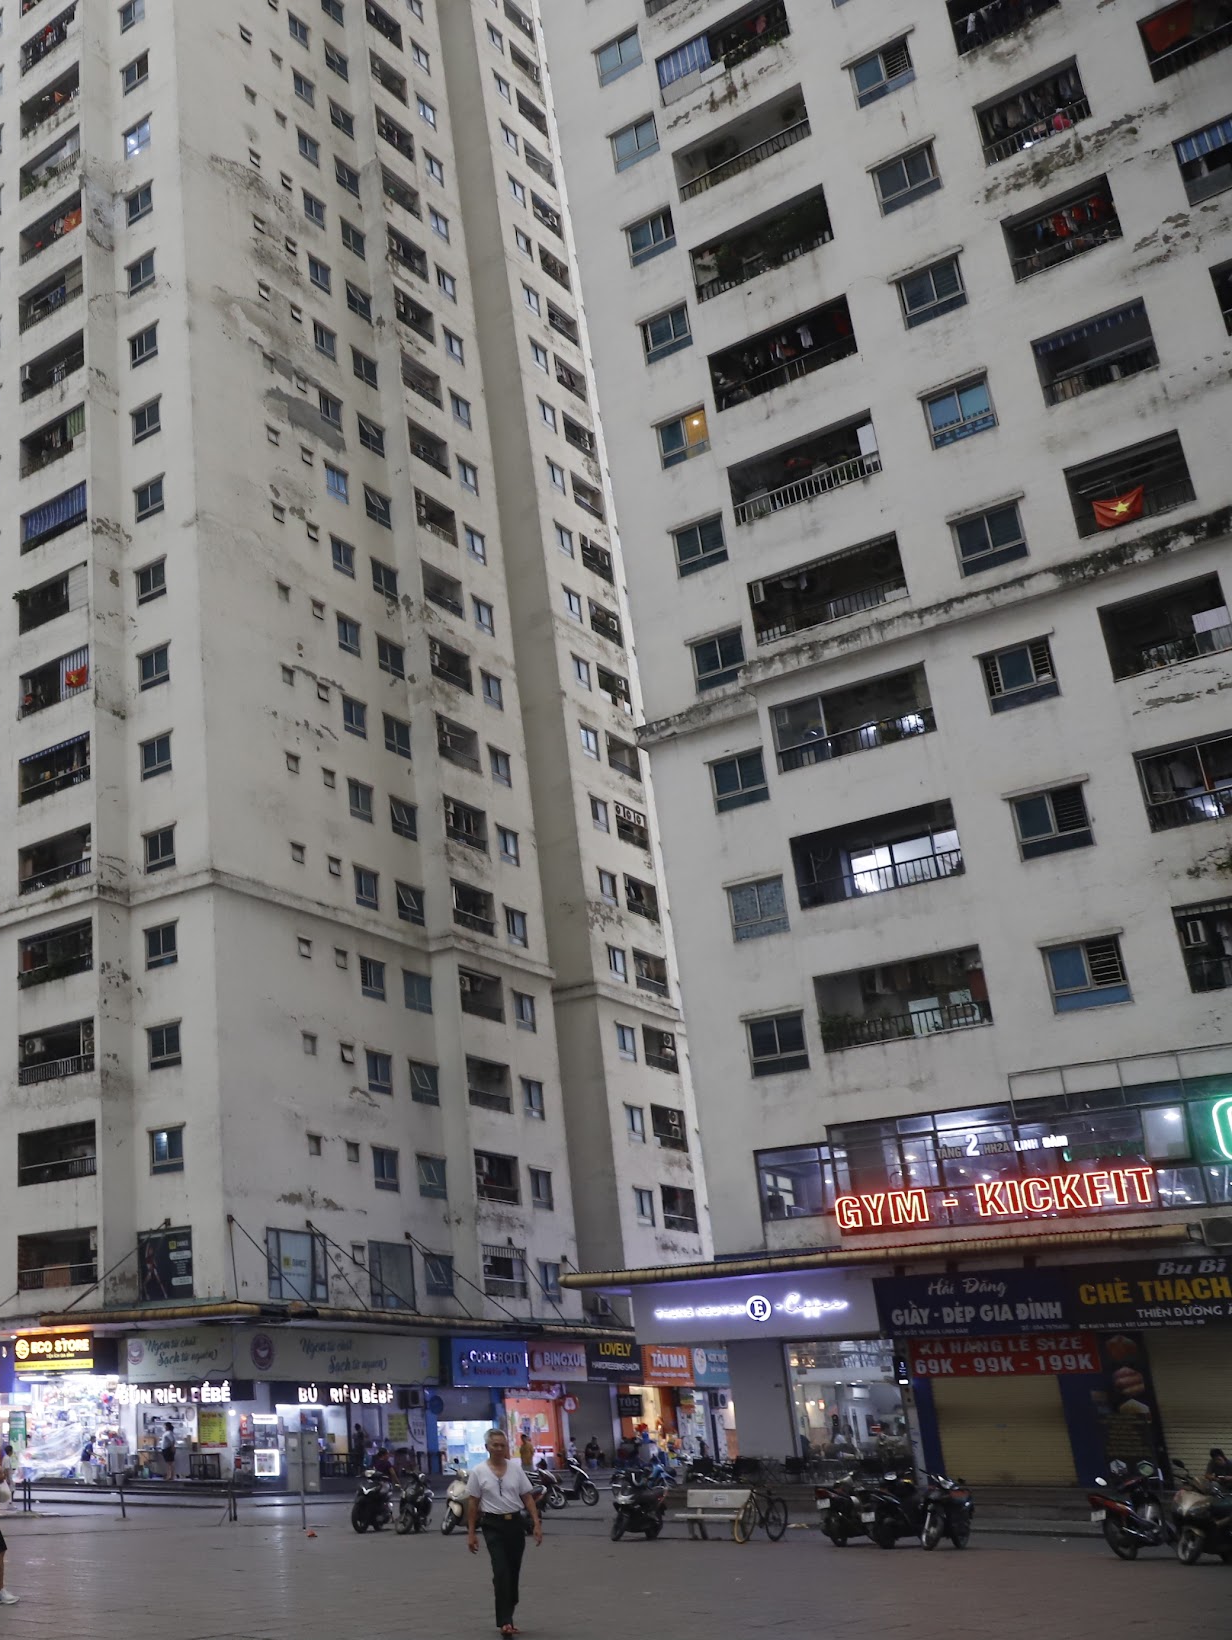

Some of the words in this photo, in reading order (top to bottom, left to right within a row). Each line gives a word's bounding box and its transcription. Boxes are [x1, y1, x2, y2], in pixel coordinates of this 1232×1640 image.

[965, 1133, 980, 1157] 2
[984, 1142, 1011, 1154] HH2A
[1014, 1138, 1039, 1151] LINH
[834, 1189, 930, 1230] GYM
[974, 1167, 1154, 1217] KICKFIT
[1157, 1261, 1193, 1275] Bu
[1079, 1276, 1133, 1305] CHÈ
[1137, 1276, 1232, 1304] THẠCH
[979, 1303, 1014, 1322] GIA
[1015, 1297, 1063, 1321] ĐÌNH
[30, 1340, 53, 1354] ECO
[54, 1338, 90, 1352] STORE
[599, 1342, 632, 1357] LOVELY
[544, 1351, 586, 1367] BINGXUE
[669, 1354, 688, 1368] MAI
[915, 1358, 955, 1375] 69K
[973, 1356, 1016, 1373] 99K
[1035, 1353, 1095, 1371] 199K
